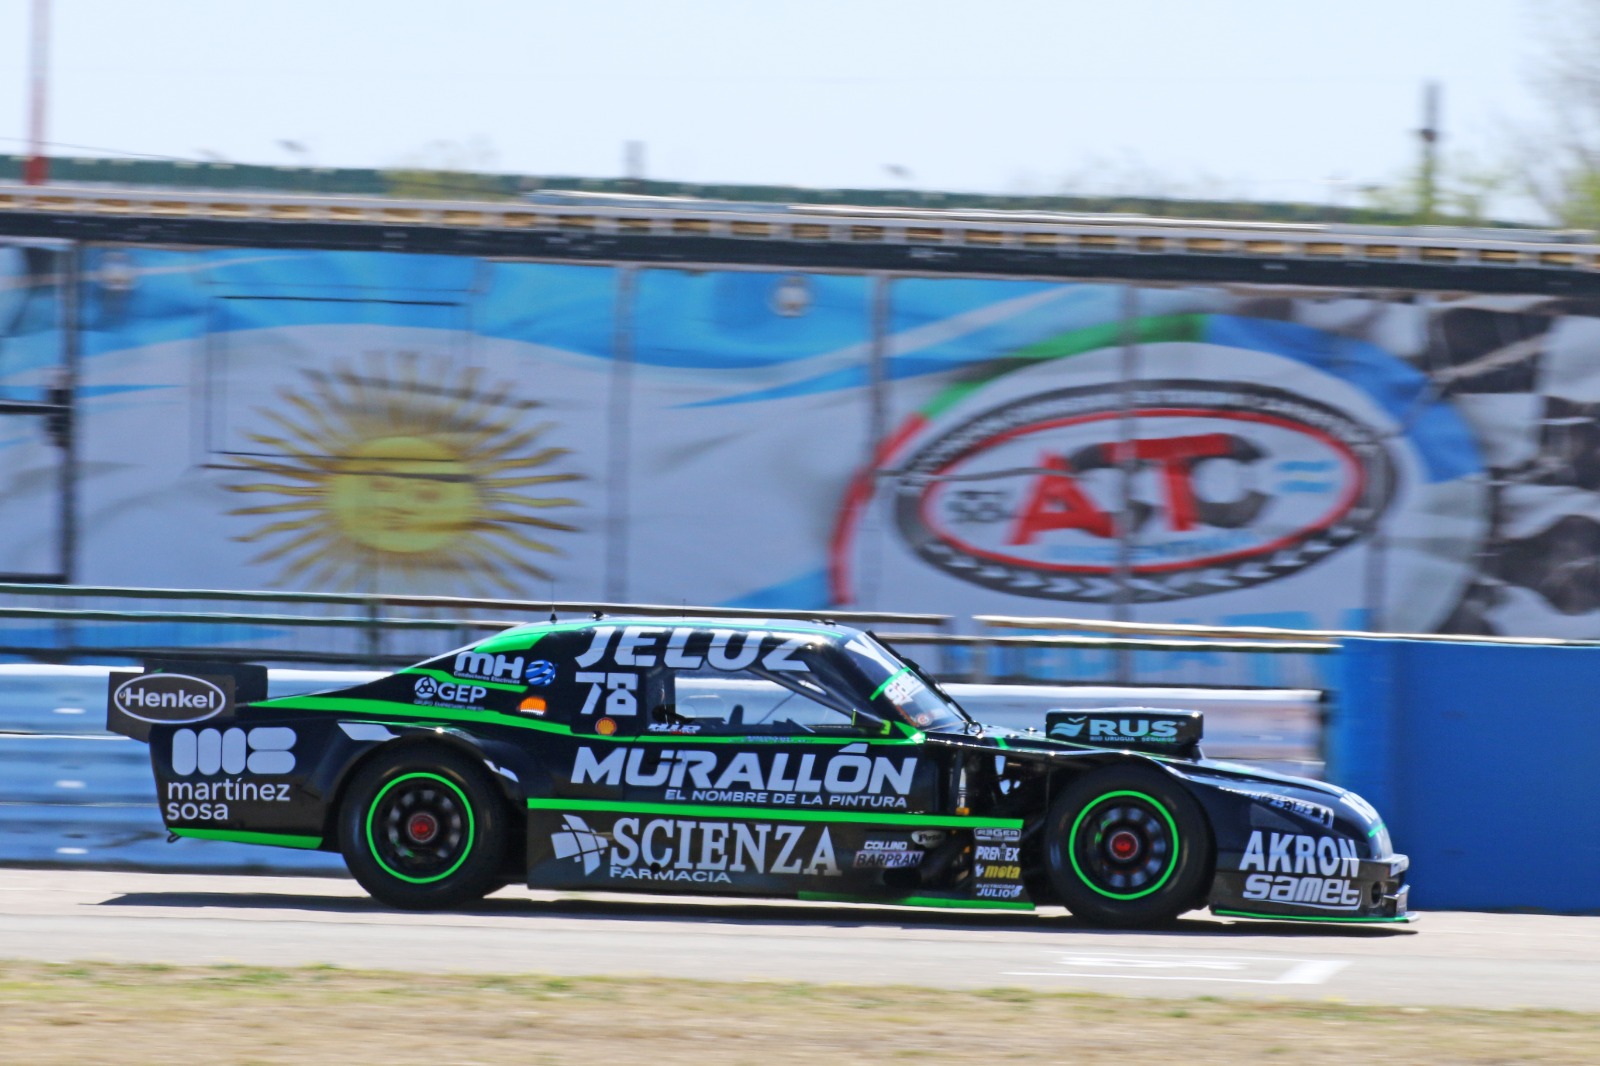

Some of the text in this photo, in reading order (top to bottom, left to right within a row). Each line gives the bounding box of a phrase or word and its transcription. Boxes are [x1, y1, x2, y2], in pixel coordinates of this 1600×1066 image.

[574, 626, 823, 672] JELUZ
[125, 687, 215, 709] Henkel
[437, 681, 487, 703] GEP
[575, 672, 638, 716] 78
[1089, 719, 1178, 737] RUS
[570, 742, 918, 795] MURALLÓN
[167, 778, 291, 802] martínez
[664, 789, 907, 808] EL NOMBRE DE LA PINTURA
[166, 802, 229, 821] sosa
[610, 817, 843, 876] SCIENZA
[1238, 830, 1360, 878] AKRON
[857, 853, 921, 868] BARPRAN
[610, 866, 732, 884] FARMACIA
[976, 888, 1011, 898] JULIO
